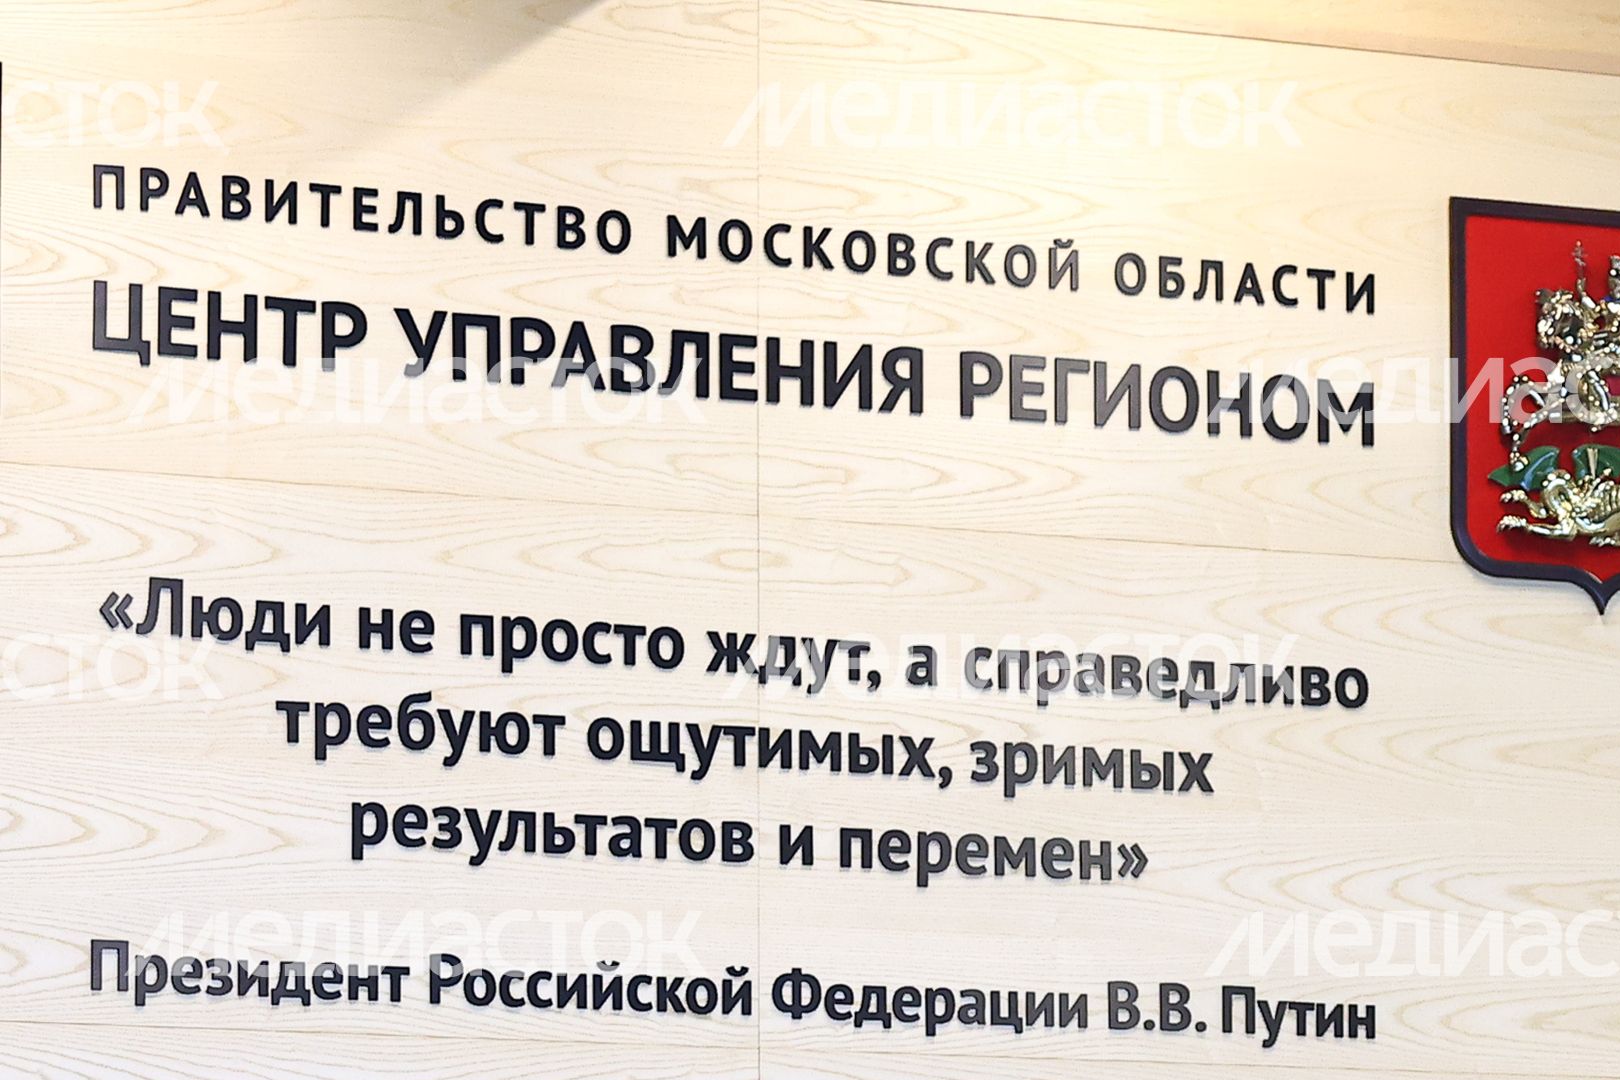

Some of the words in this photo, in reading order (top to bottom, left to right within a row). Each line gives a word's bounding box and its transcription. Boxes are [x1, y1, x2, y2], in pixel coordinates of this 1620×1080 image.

[93, 164, 632, 255] ПРАВИТЕЛЬСТВО
[666, 214, 1079, 292] МОСКОВСКОЙ
[1114, 252, 1375, 315] ОБЛАСТИ
[92, 280, 368, 372] ЦЕНТР
[393, 308, 924, 415] УПРАВЛЕНИЯ
[959, 351, 1375, 448] РЕГИОНОМ
[99, 577, 331, 652] «Люди
[358, 606, 435, 653] не
[459, 613, 685, 673] просто
[705, 630, 882, 695] ждут,
[907, 645, 934, 687] а
[972, 644, 1369, 711] справедливо
[275, 691, 566, 768] требуют
[586, 717, 953, 791] ощутимых,
[969, 740, 1215, 799] зримых
[351, 801, 755, 867] результатов
[779, 824, 814, 867] и
[839, 827, 1149, 888] перемен»
[90, 940, 411, 1007] Президент
[429, 952, 753, 1016] Российской
[771, 967, 1088, 1037] Федерации
[1107, 981, 1207, 1033] В.В.
[1221, 985, 1376, 1049] Путин
